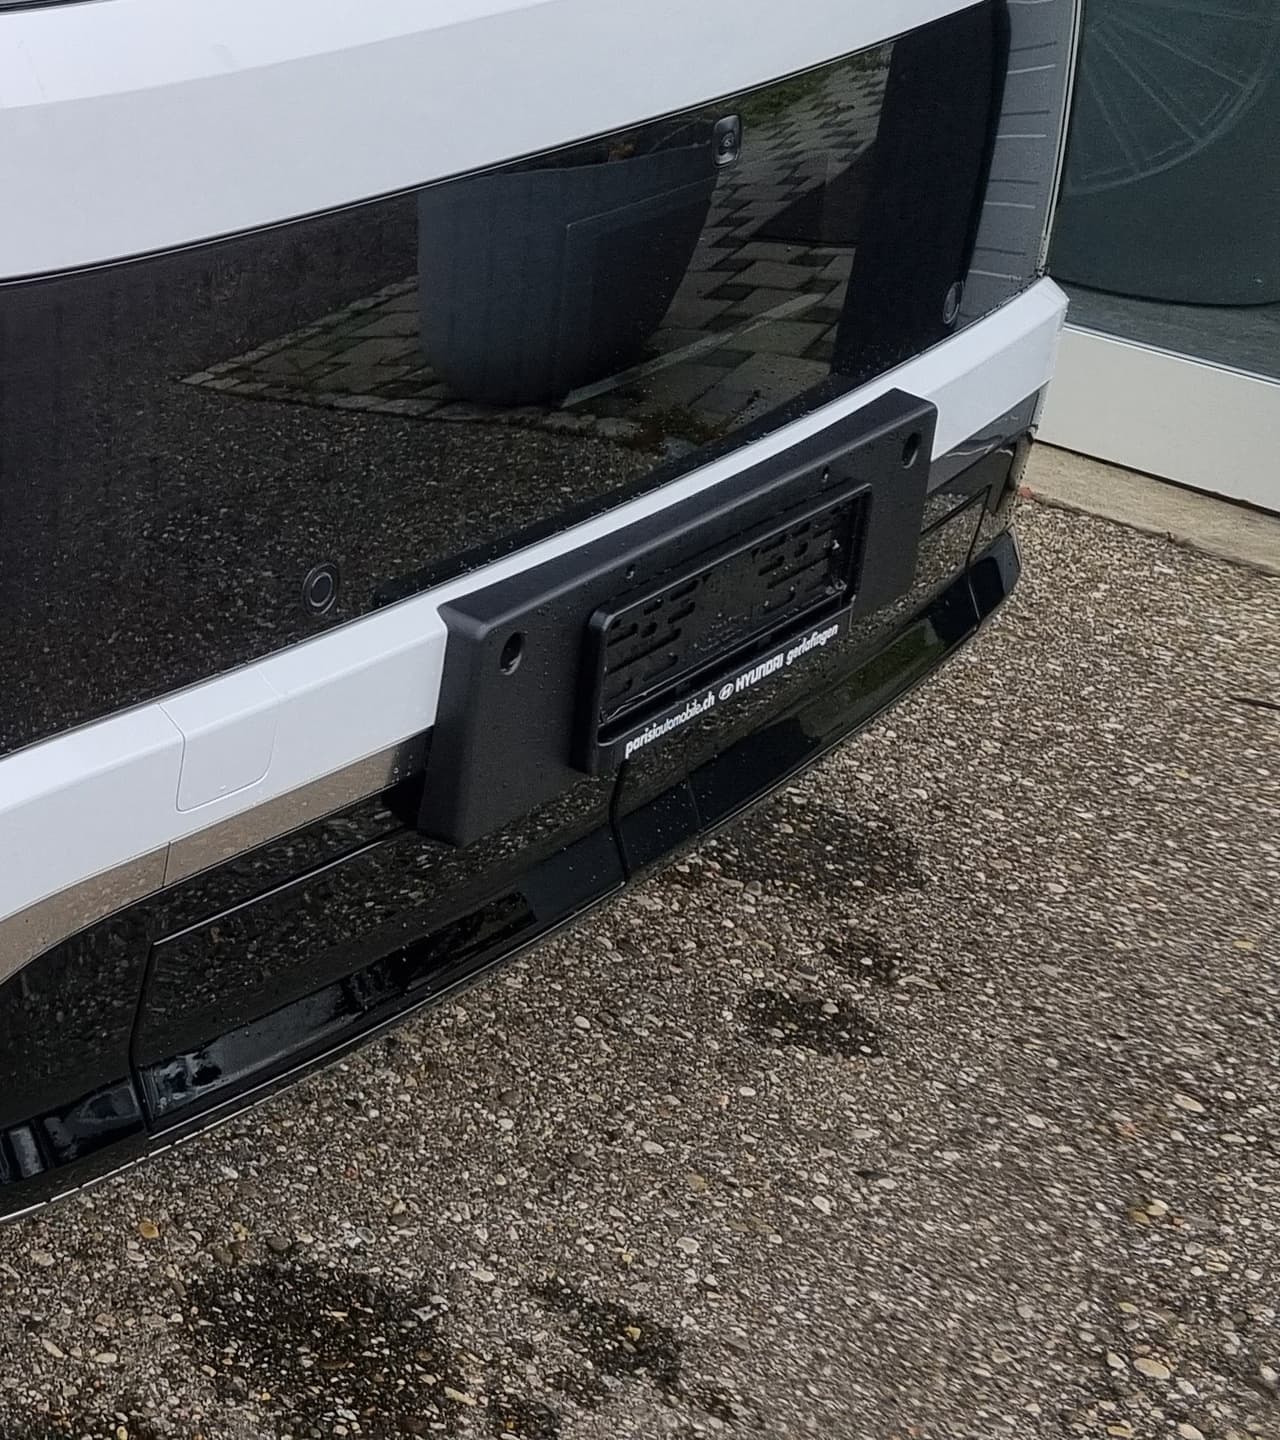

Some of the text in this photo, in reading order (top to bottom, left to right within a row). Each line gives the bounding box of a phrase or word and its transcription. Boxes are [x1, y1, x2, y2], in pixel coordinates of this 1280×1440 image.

[624, 624, 840, 760] parisiautomobile.ch HYUNDAI gerlafingen
